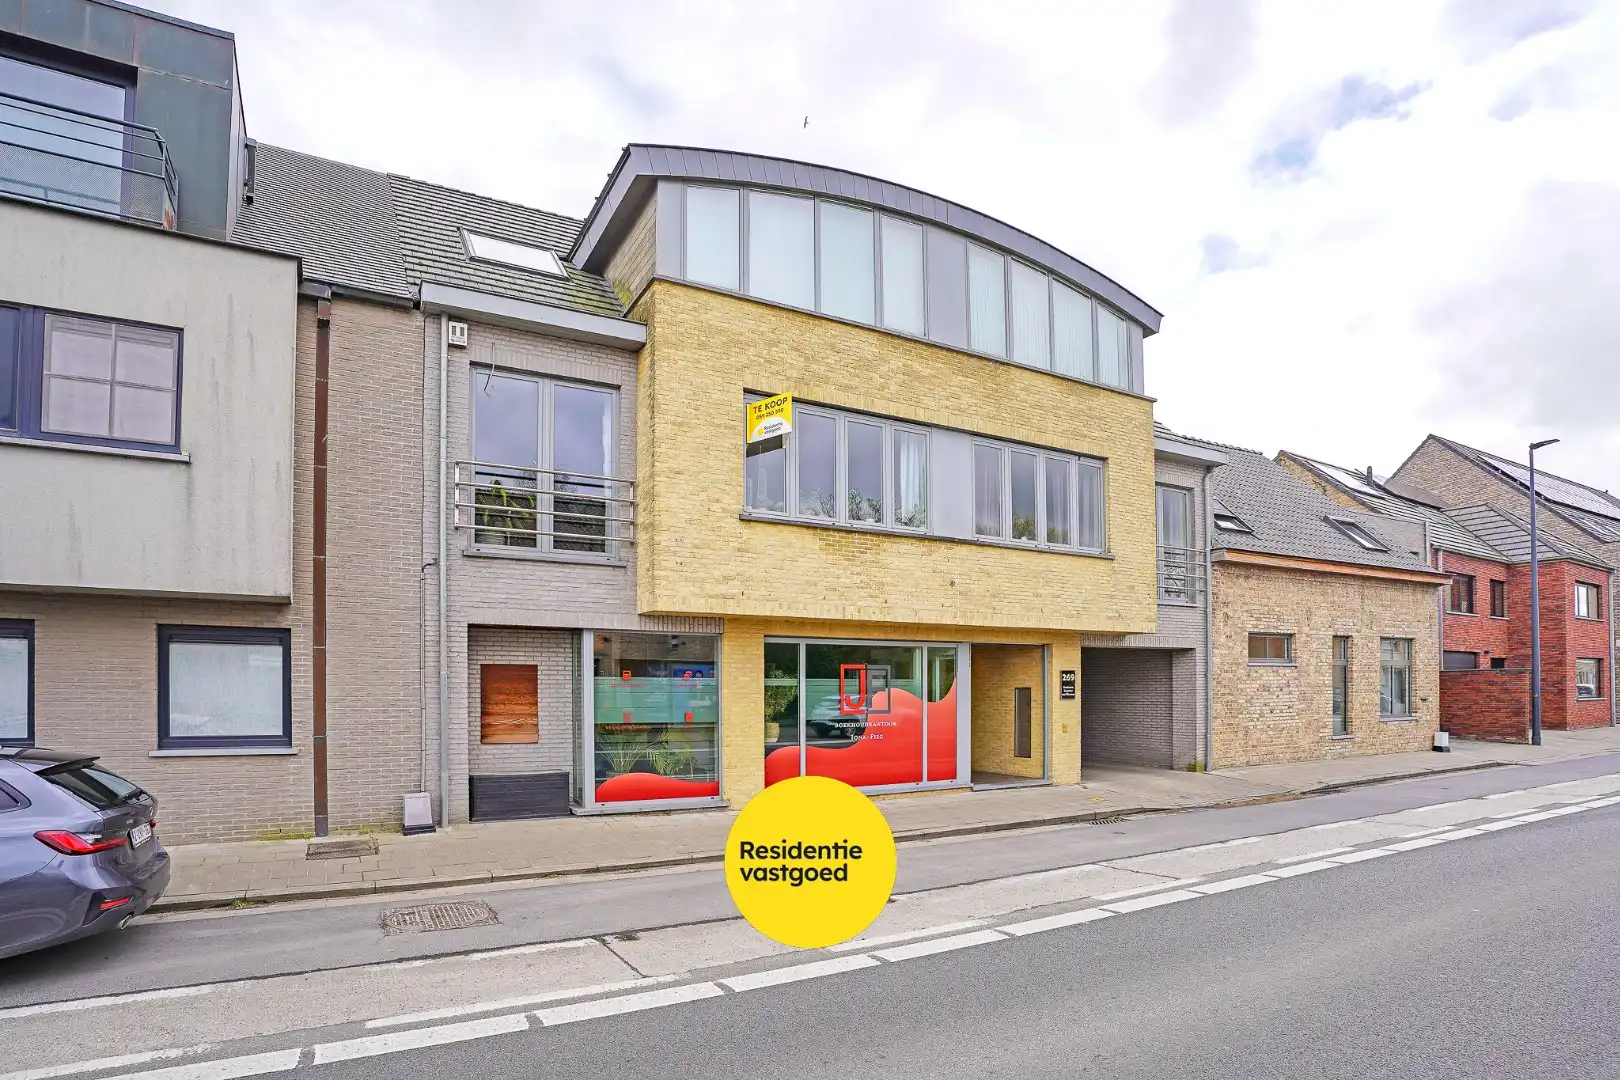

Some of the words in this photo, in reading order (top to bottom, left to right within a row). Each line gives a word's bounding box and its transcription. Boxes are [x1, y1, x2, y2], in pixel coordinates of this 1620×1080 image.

[753, 404, 763, 414] TE
[765, 397, 788, 410] KOOP
[1062, 673, 1075, 681] 269
